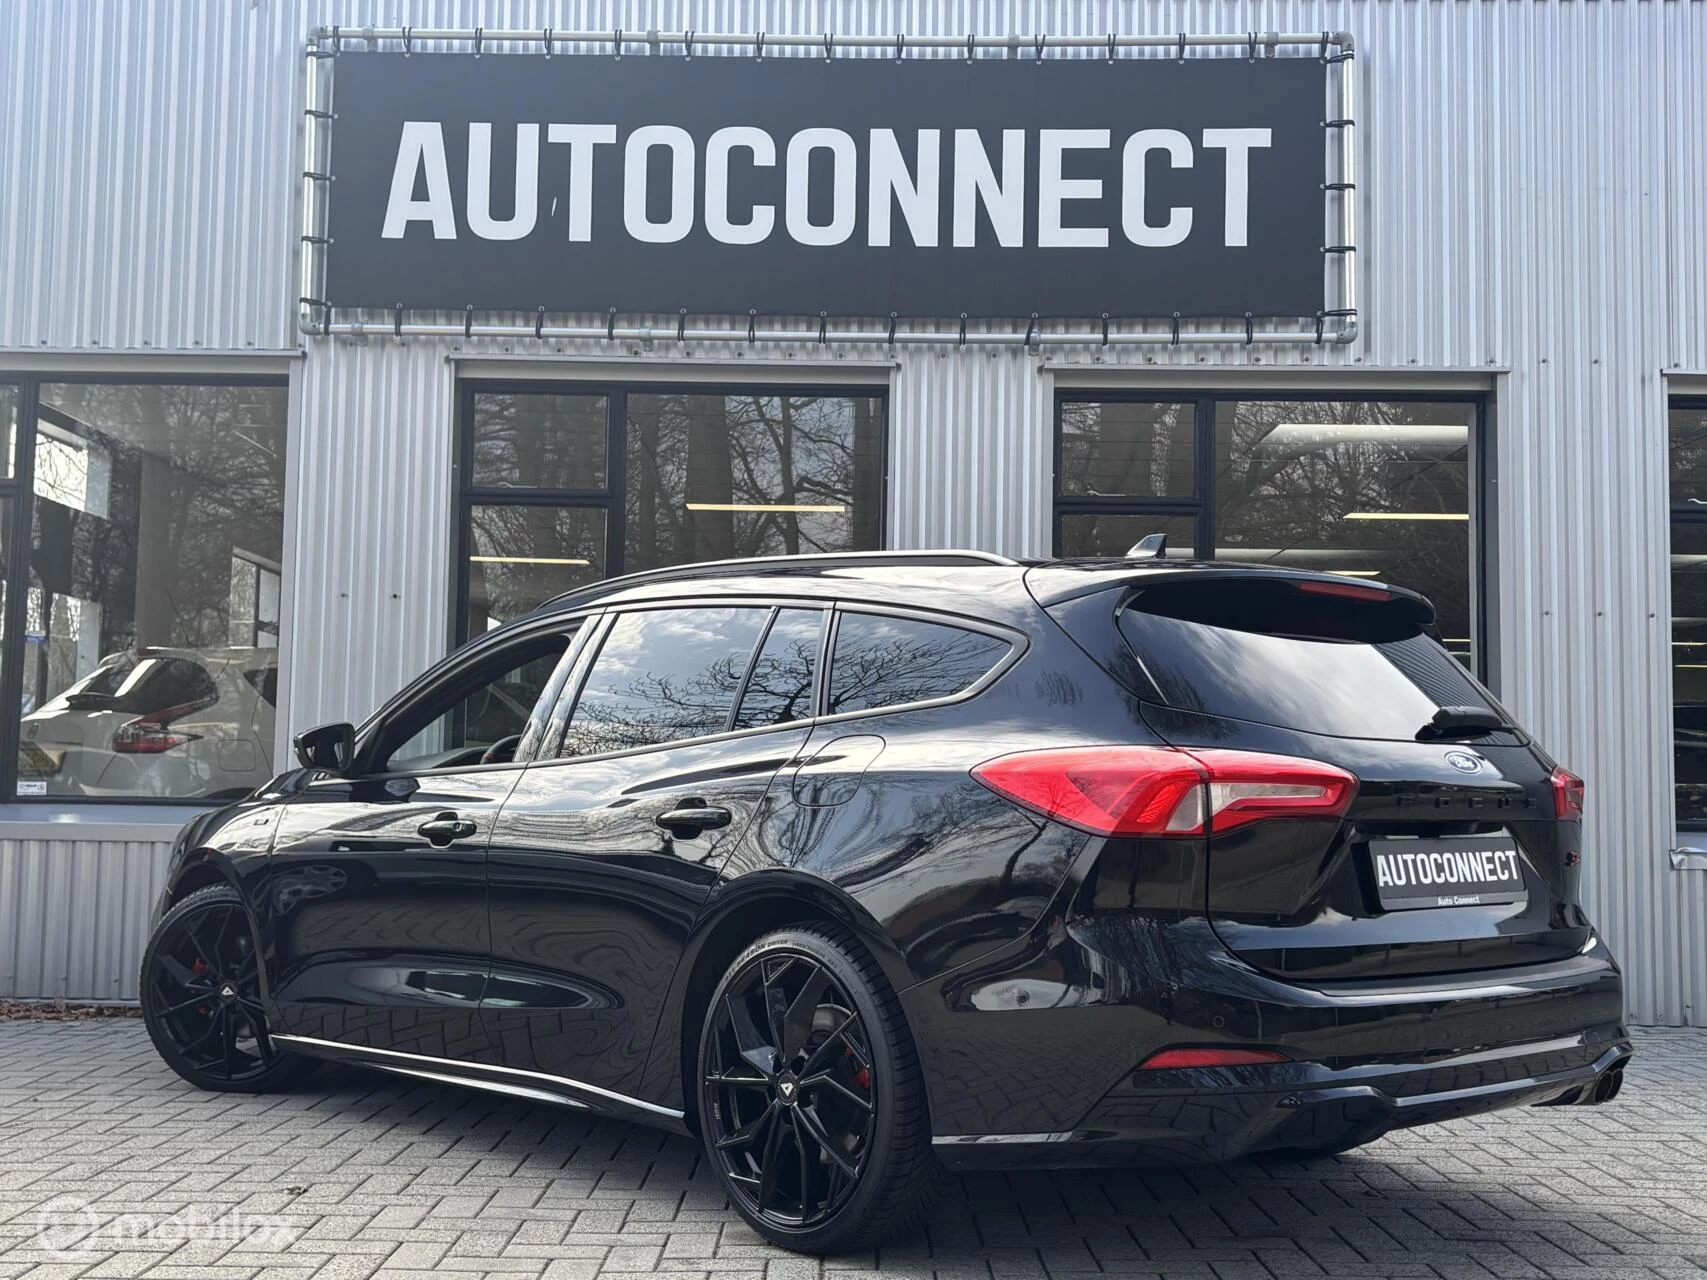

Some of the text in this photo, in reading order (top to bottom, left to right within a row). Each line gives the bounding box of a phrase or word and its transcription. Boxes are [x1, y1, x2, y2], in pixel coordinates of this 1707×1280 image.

[381, 121, 1272, 247] AUTOCONNECT
[1377, 851, 1518, 887] AUTOCONNECT
[1438, 895, 1480, 906] Auto Connect
